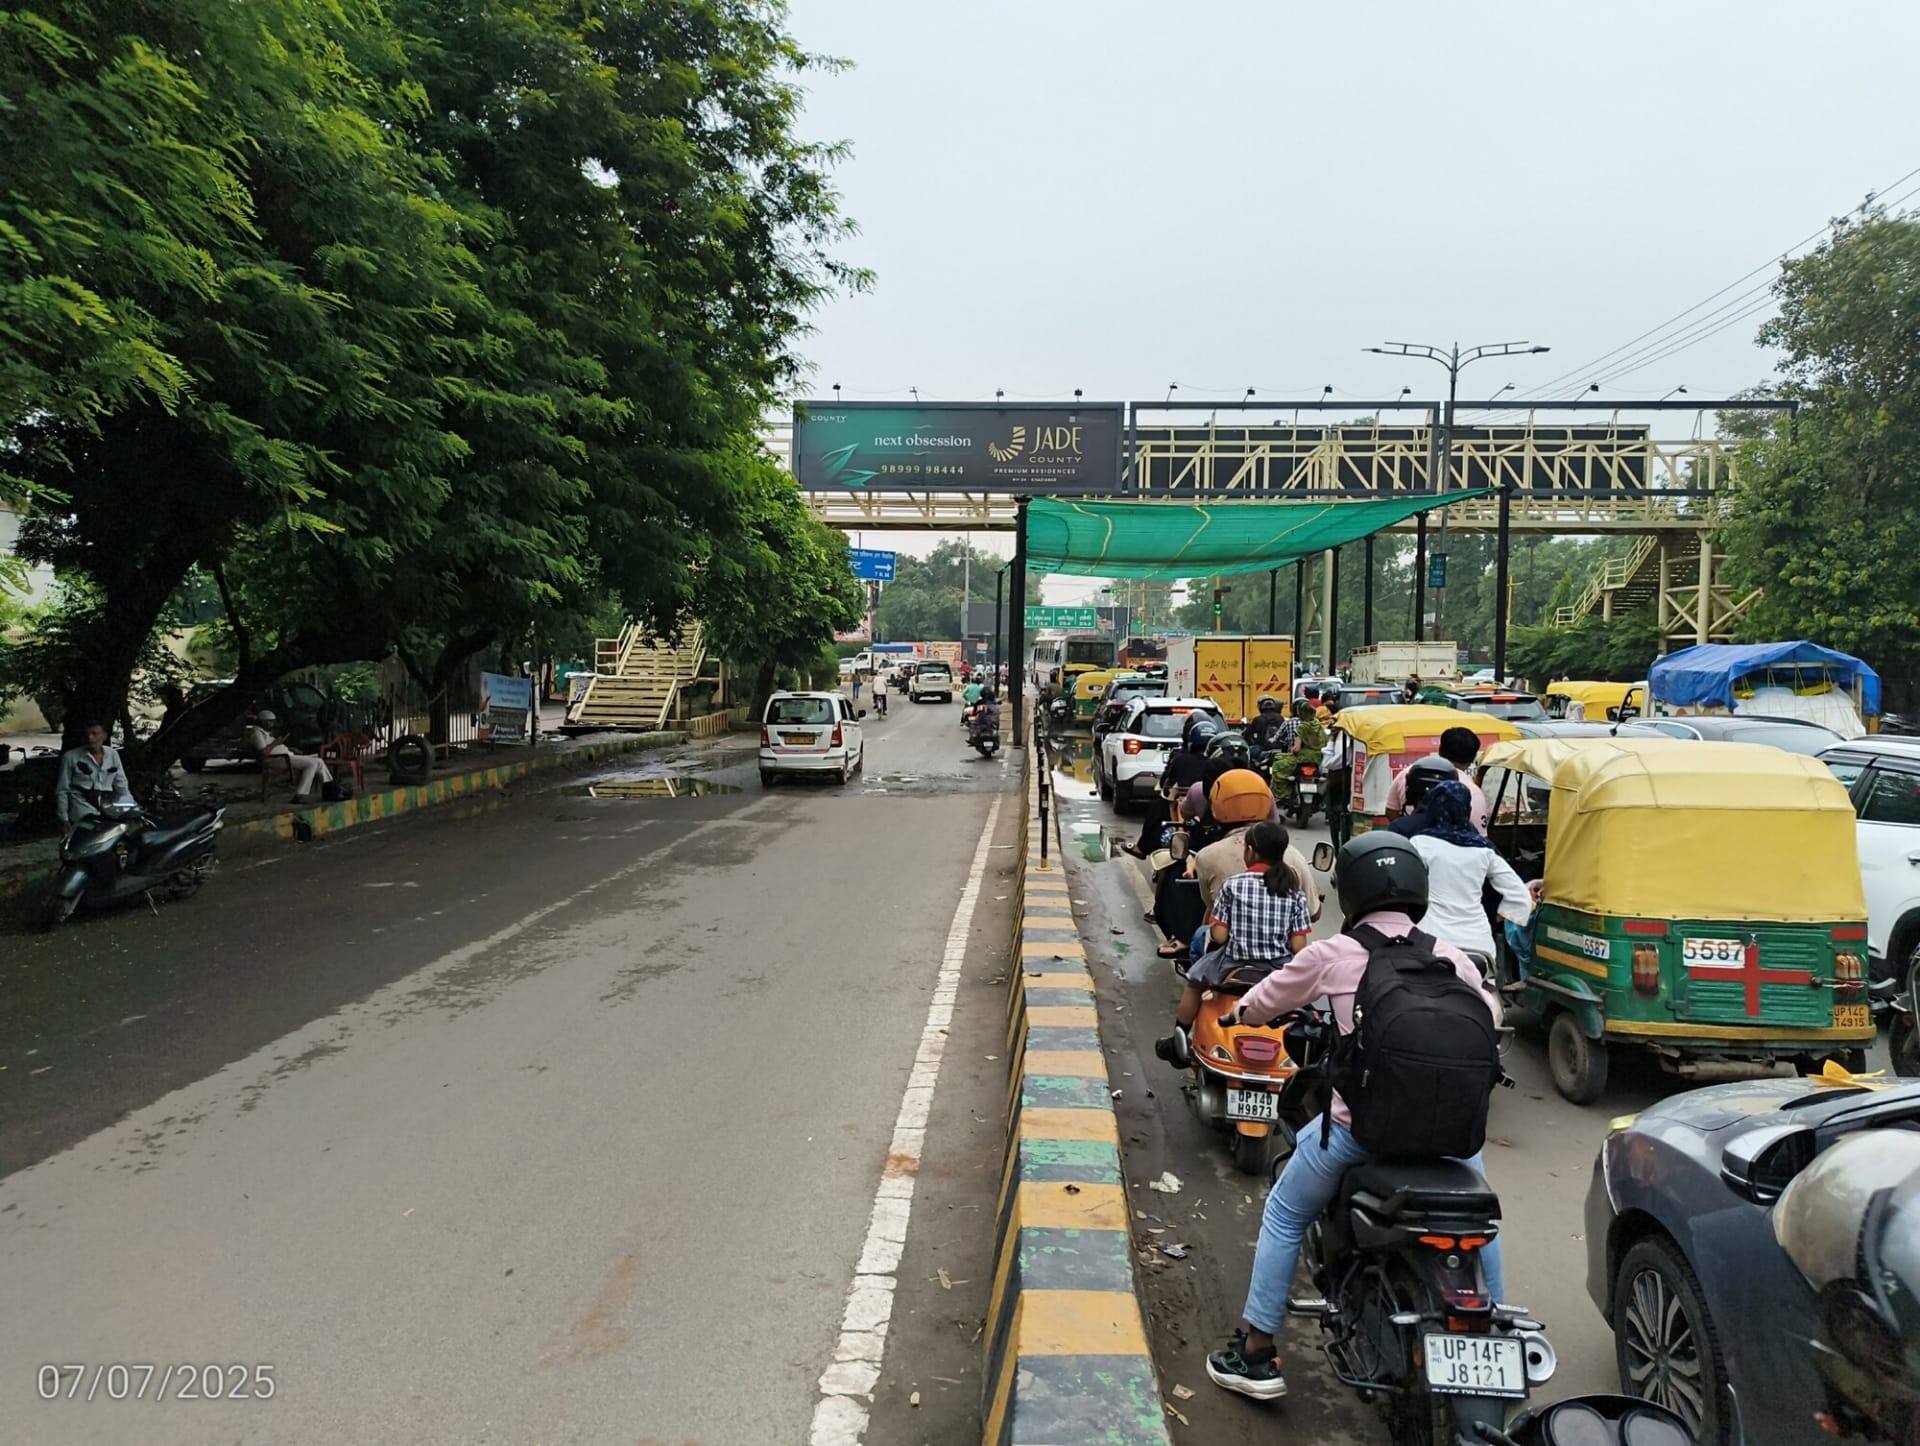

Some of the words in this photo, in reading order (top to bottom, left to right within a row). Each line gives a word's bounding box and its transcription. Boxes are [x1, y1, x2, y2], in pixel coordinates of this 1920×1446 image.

[810, 415, 848, 423] COUNTY
[874, 436, 903, 447] next
[905, 433, 972, 447] obsession
[1028, 426, 1084, 455] JADE
[881, 464, 920, 473] 98999
[925, 465, 964, 474] 98444
[1376, 856, 1396, 867] TVS
[1584, 939, 1607, 957] 5587
[1684, 940, 1745, 961] 5587
[1238, 1103, 1272, 1118] H9873
[1443, 1338, 1503, 1363] UP14F
[1447, 1363, 1505, 1387] J8121
